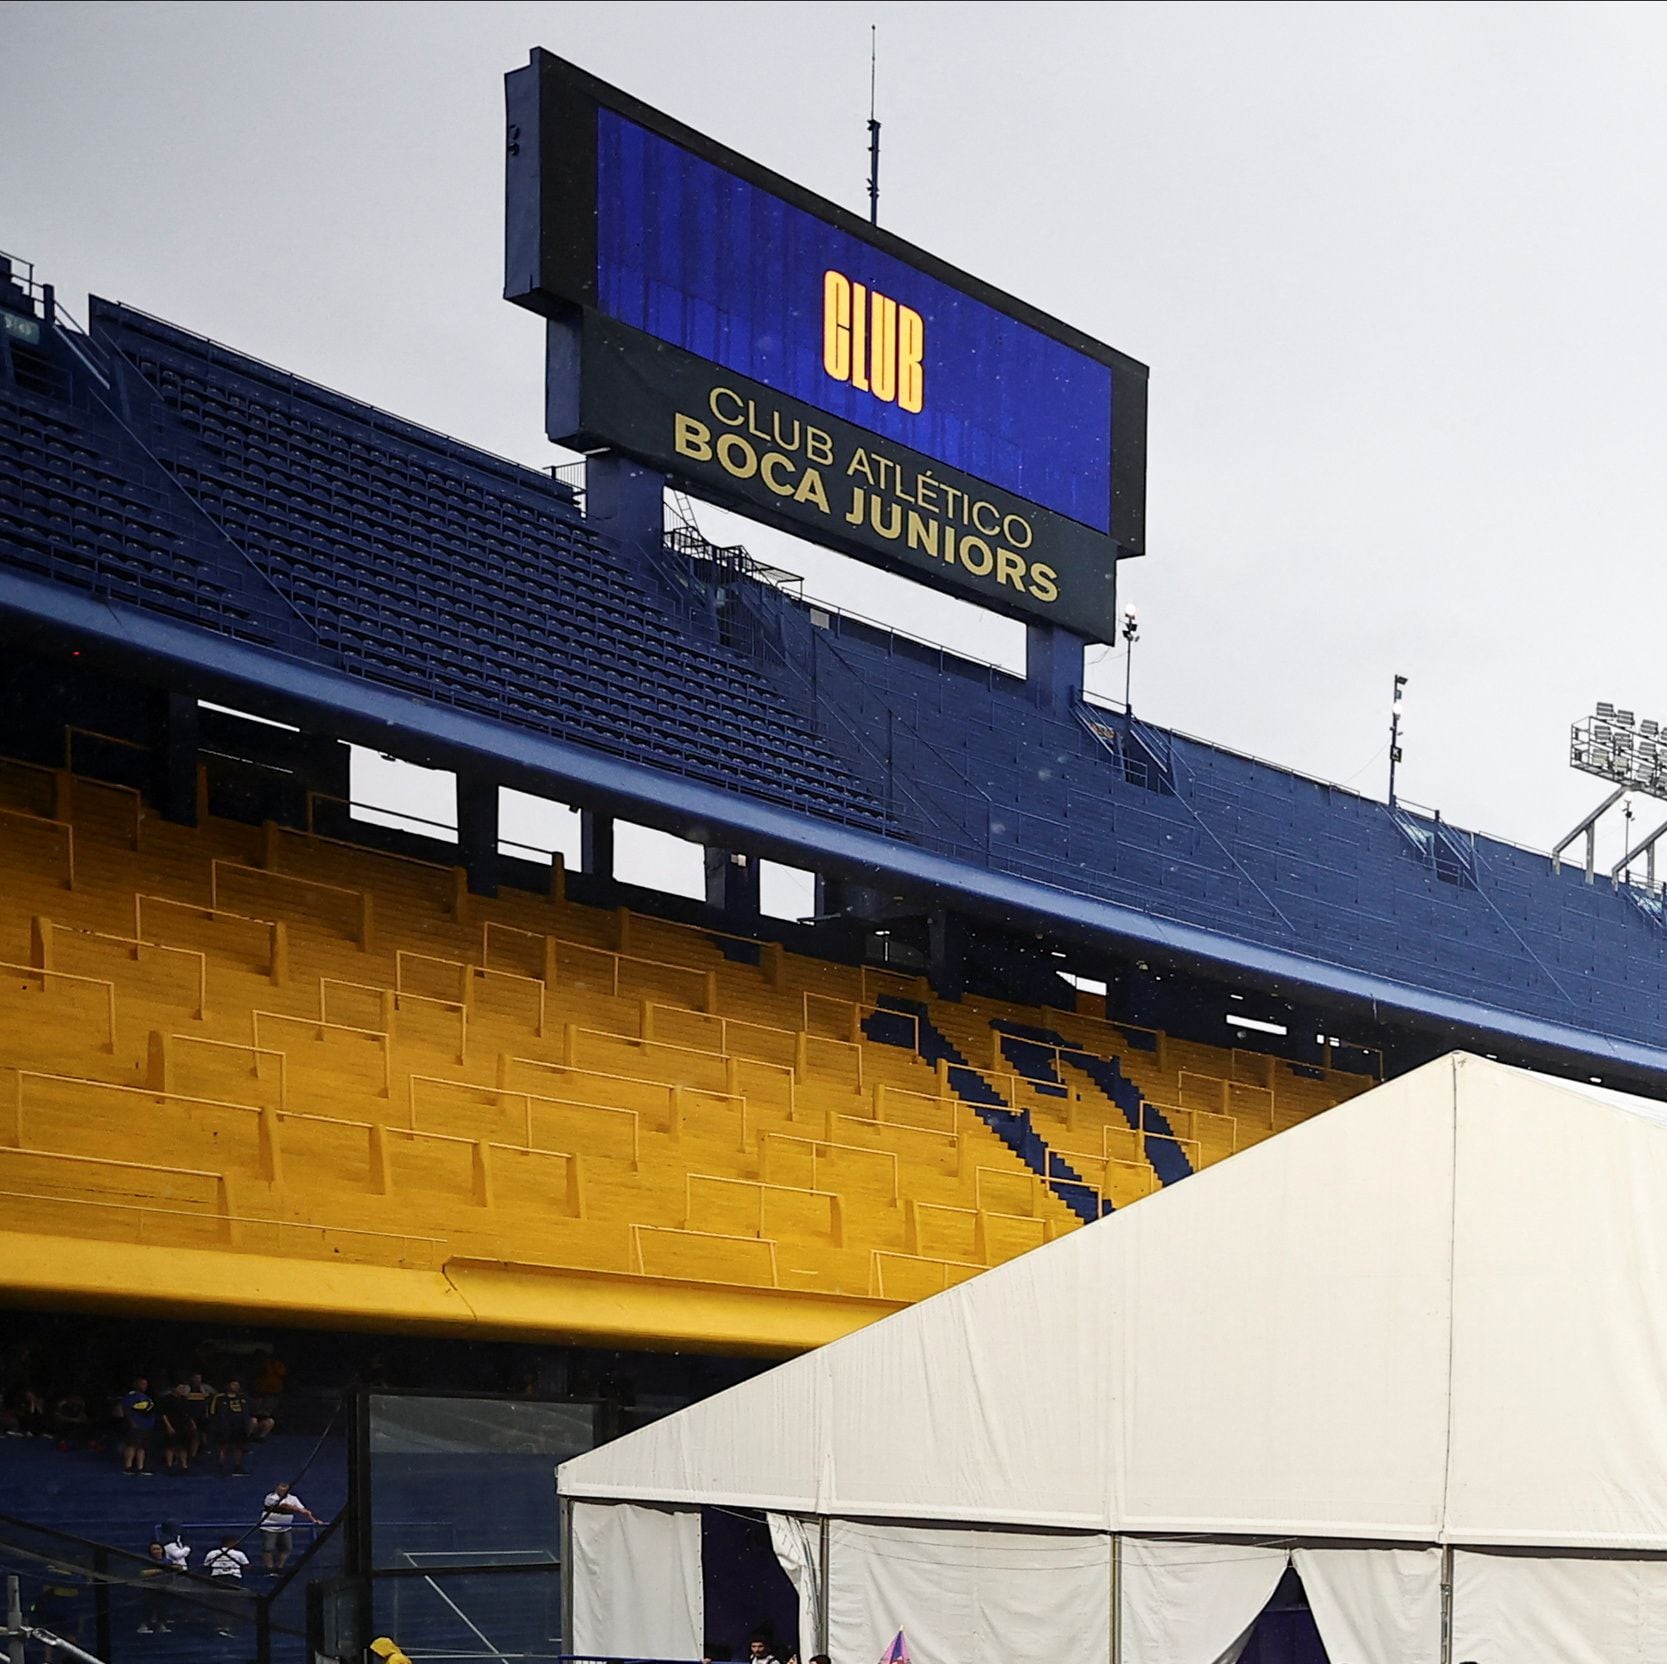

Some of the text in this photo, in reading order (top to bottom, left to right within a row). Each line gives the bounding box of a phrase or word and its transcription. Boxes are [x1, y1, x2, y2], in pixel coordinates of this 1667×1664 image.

[823, 269, 924, 414] CLUB
[674, 412, 1058, 602] BOCA JUNIORS
[709, 387, 1033, 549] CLUB ATLÉTICO
